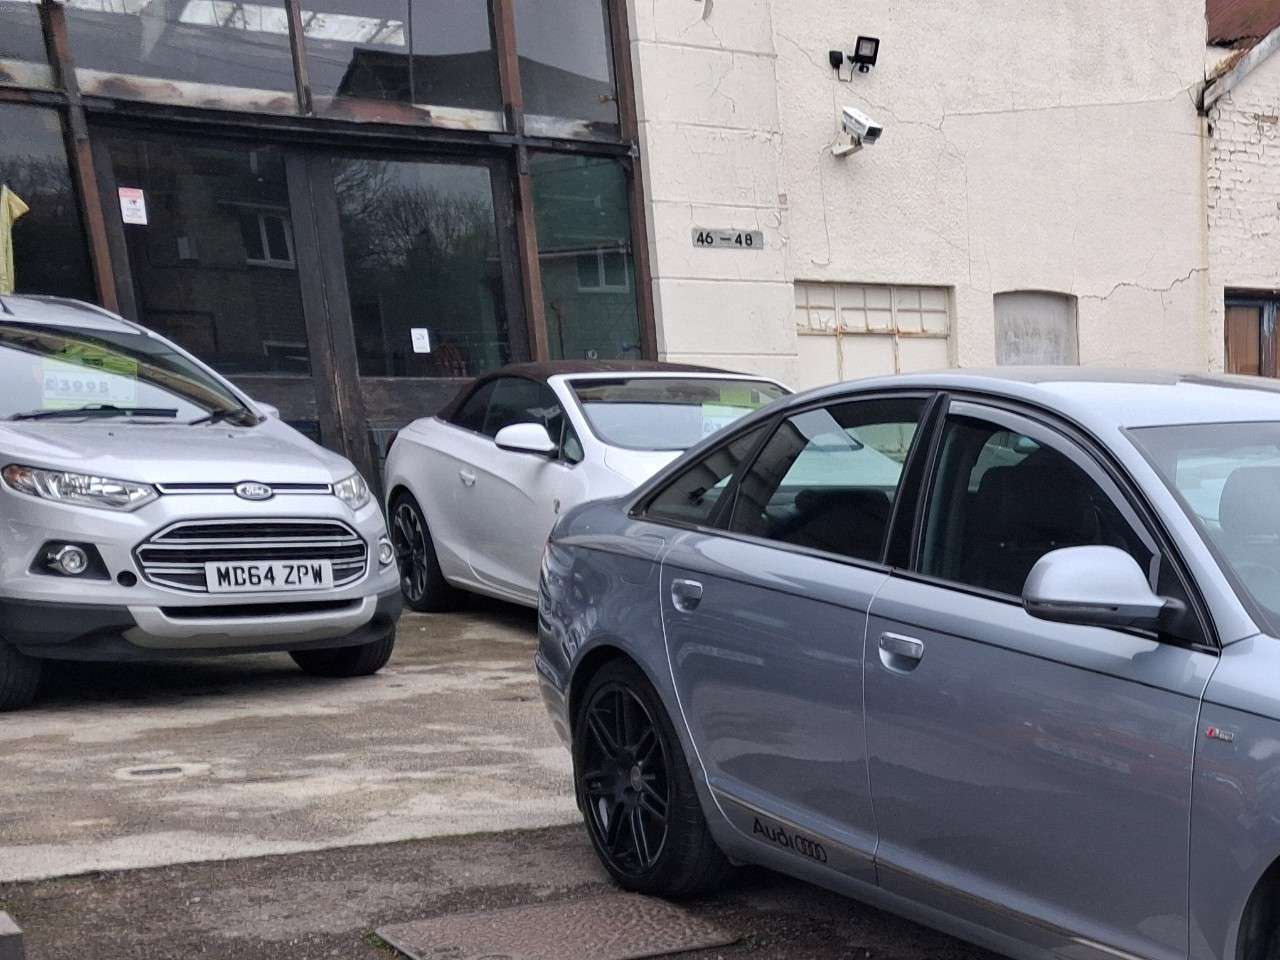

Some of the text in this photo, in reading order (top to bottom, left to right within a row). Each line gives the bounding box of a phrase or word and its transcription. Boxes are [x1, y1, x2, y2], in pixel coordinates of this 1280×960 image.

[696, 231, 714, 246] 46
[734, 232, 753, 247] 48
[281, 563, 323, 586] ZPW
[752, 815, 795, 849] Audi
